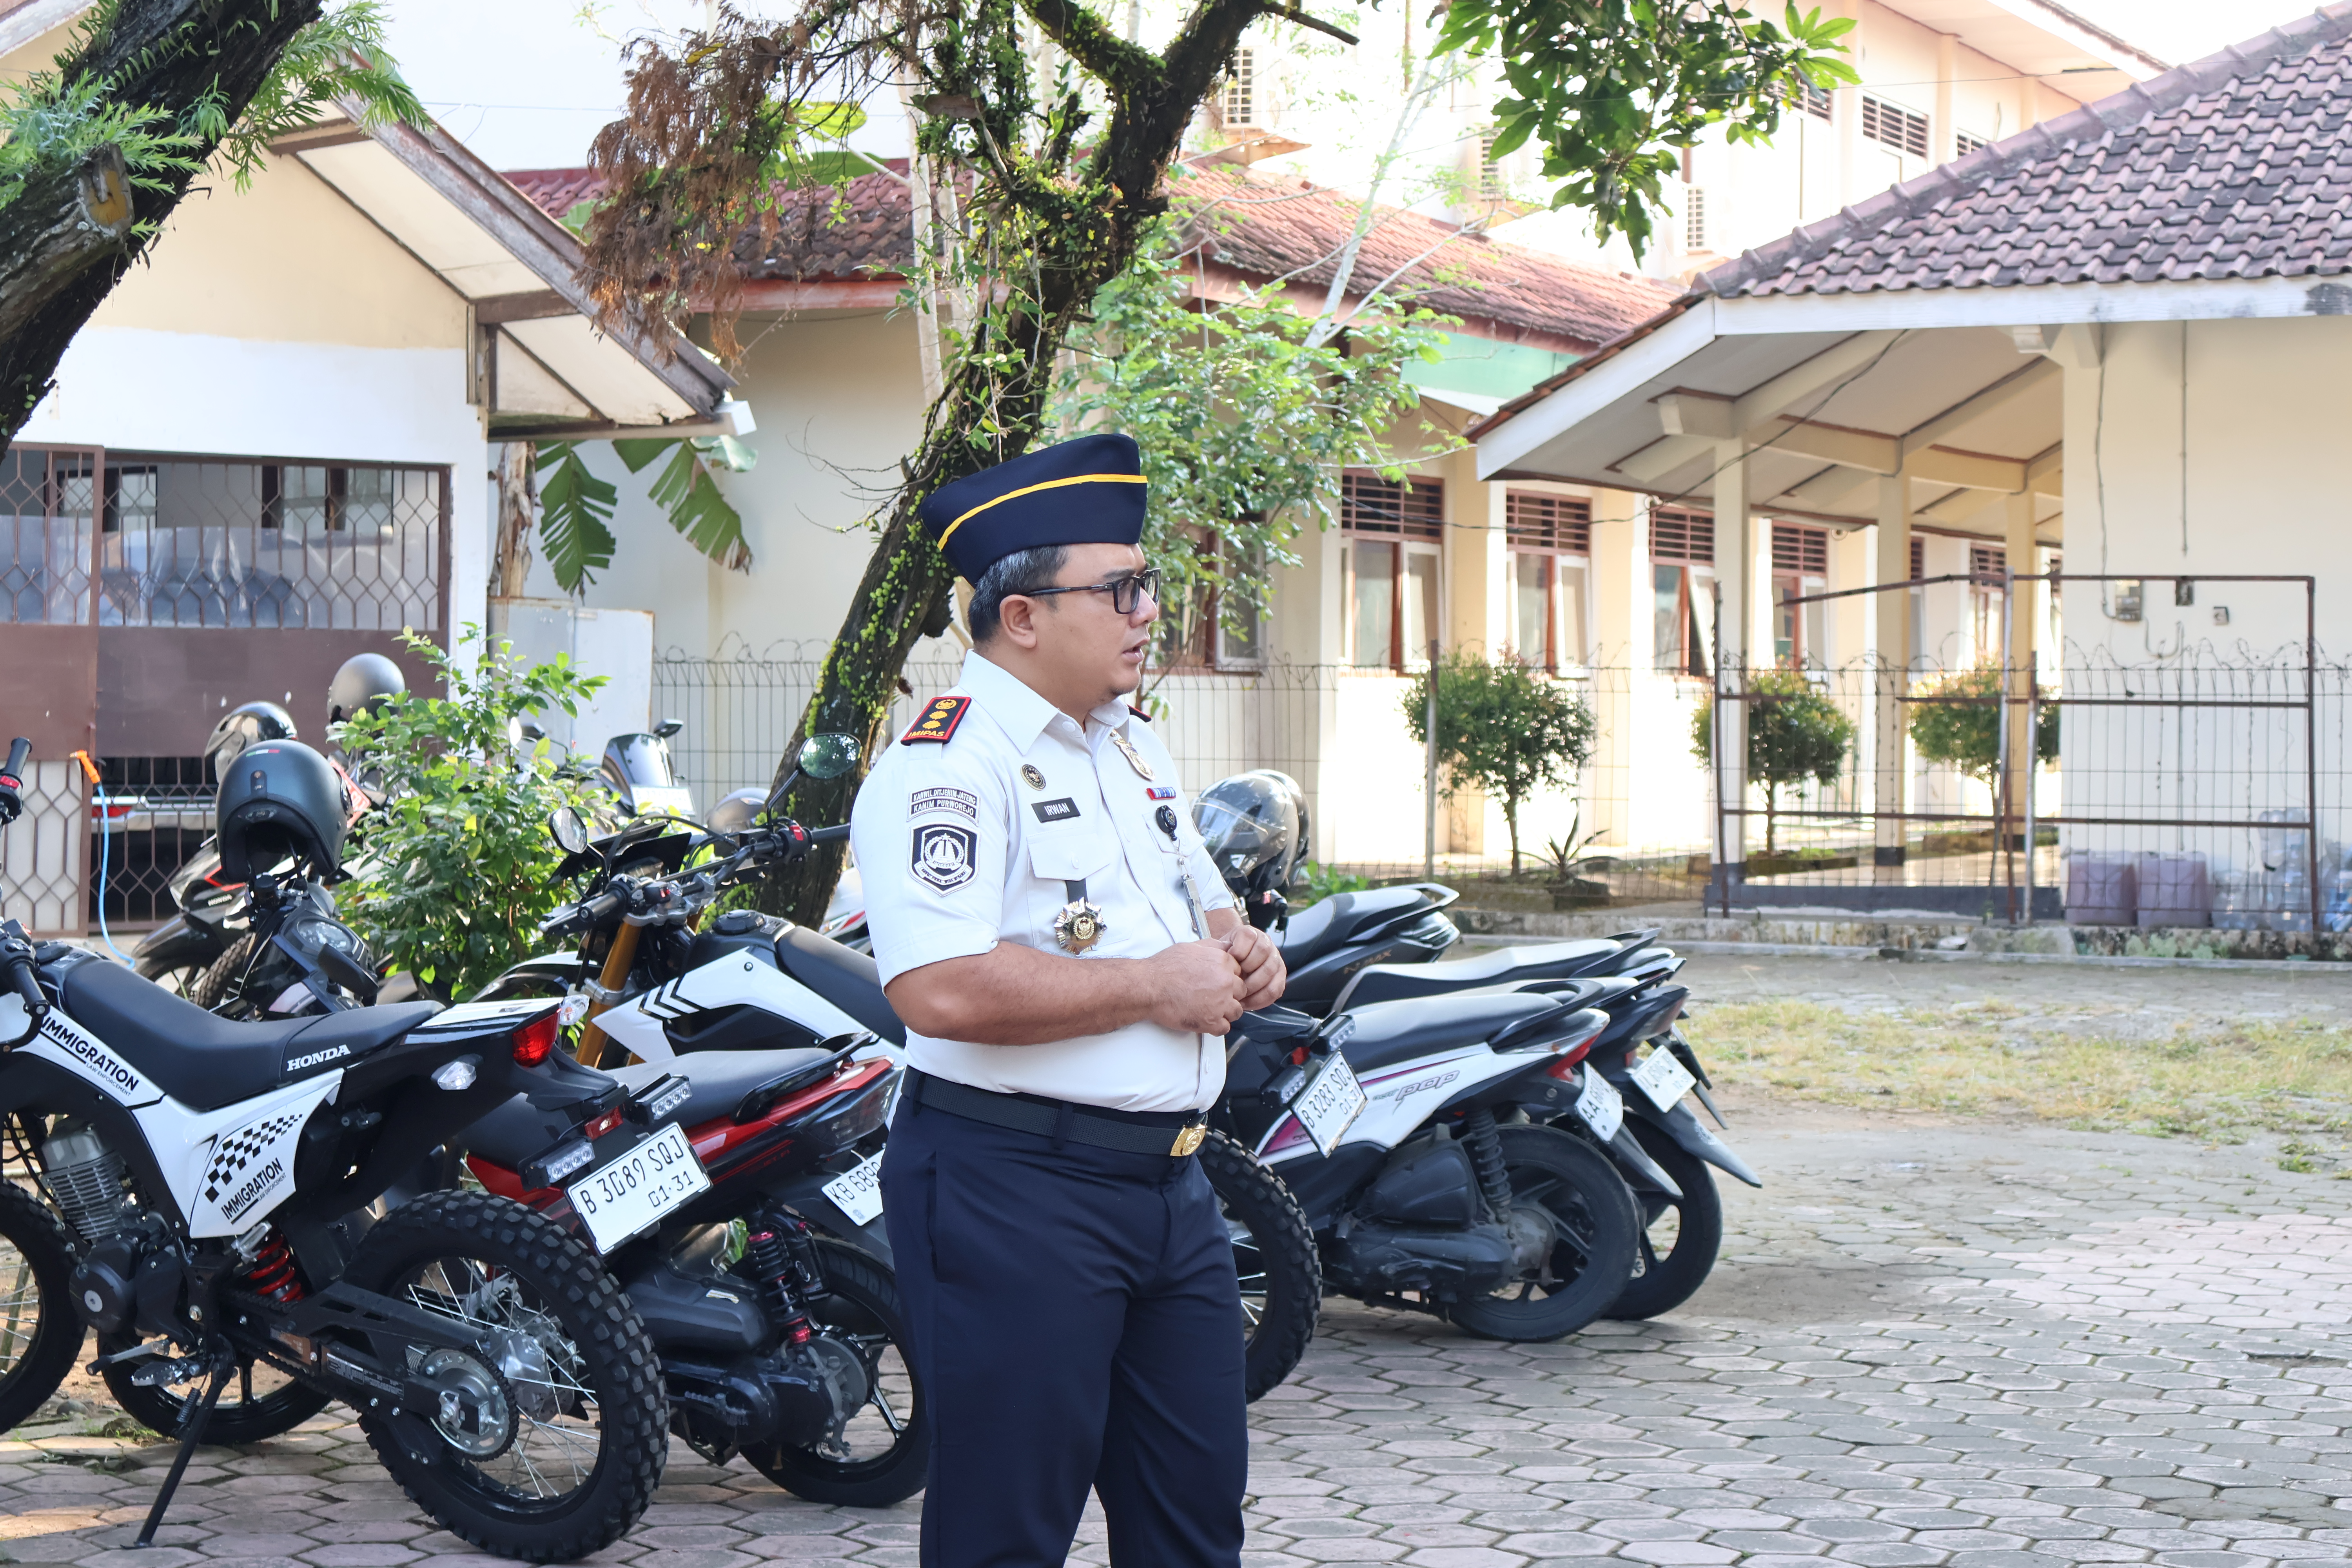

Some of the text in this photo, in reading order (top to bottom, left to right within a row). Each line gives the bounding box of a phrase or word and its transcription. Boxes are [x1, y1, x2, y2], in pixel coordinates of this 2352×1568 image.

[913, 789, 976, 804] KANWIL DITJENIM JATENG
[914, 800, 974, 816] KANIM PURWOREJO
[1044, 802, 1070, 816] IRWAN
[207, 893, 232, 906] HONDA
[42, 1016, 139, 1091] IMMIGRATION
[287, 1044, 351, 1072] HONDA
[86, 1063, 131, 1096] LAW ENFORCEMENT
[1396, 1070, 1460, 1101] pop
[1301, 1110, 1315, 1128] B
[1309, 1083, 1336, 1118] 3283
[1582, 1099, 1601, 1123] AA
[265, 1172, 286, 1195] ENFORCEMENT
[580, 1135, 684, 1214] B 3089 SQJ
[221, 1157, 283, 1220] IMMIGRATION
[828, 1183, 855, 1206] KB
